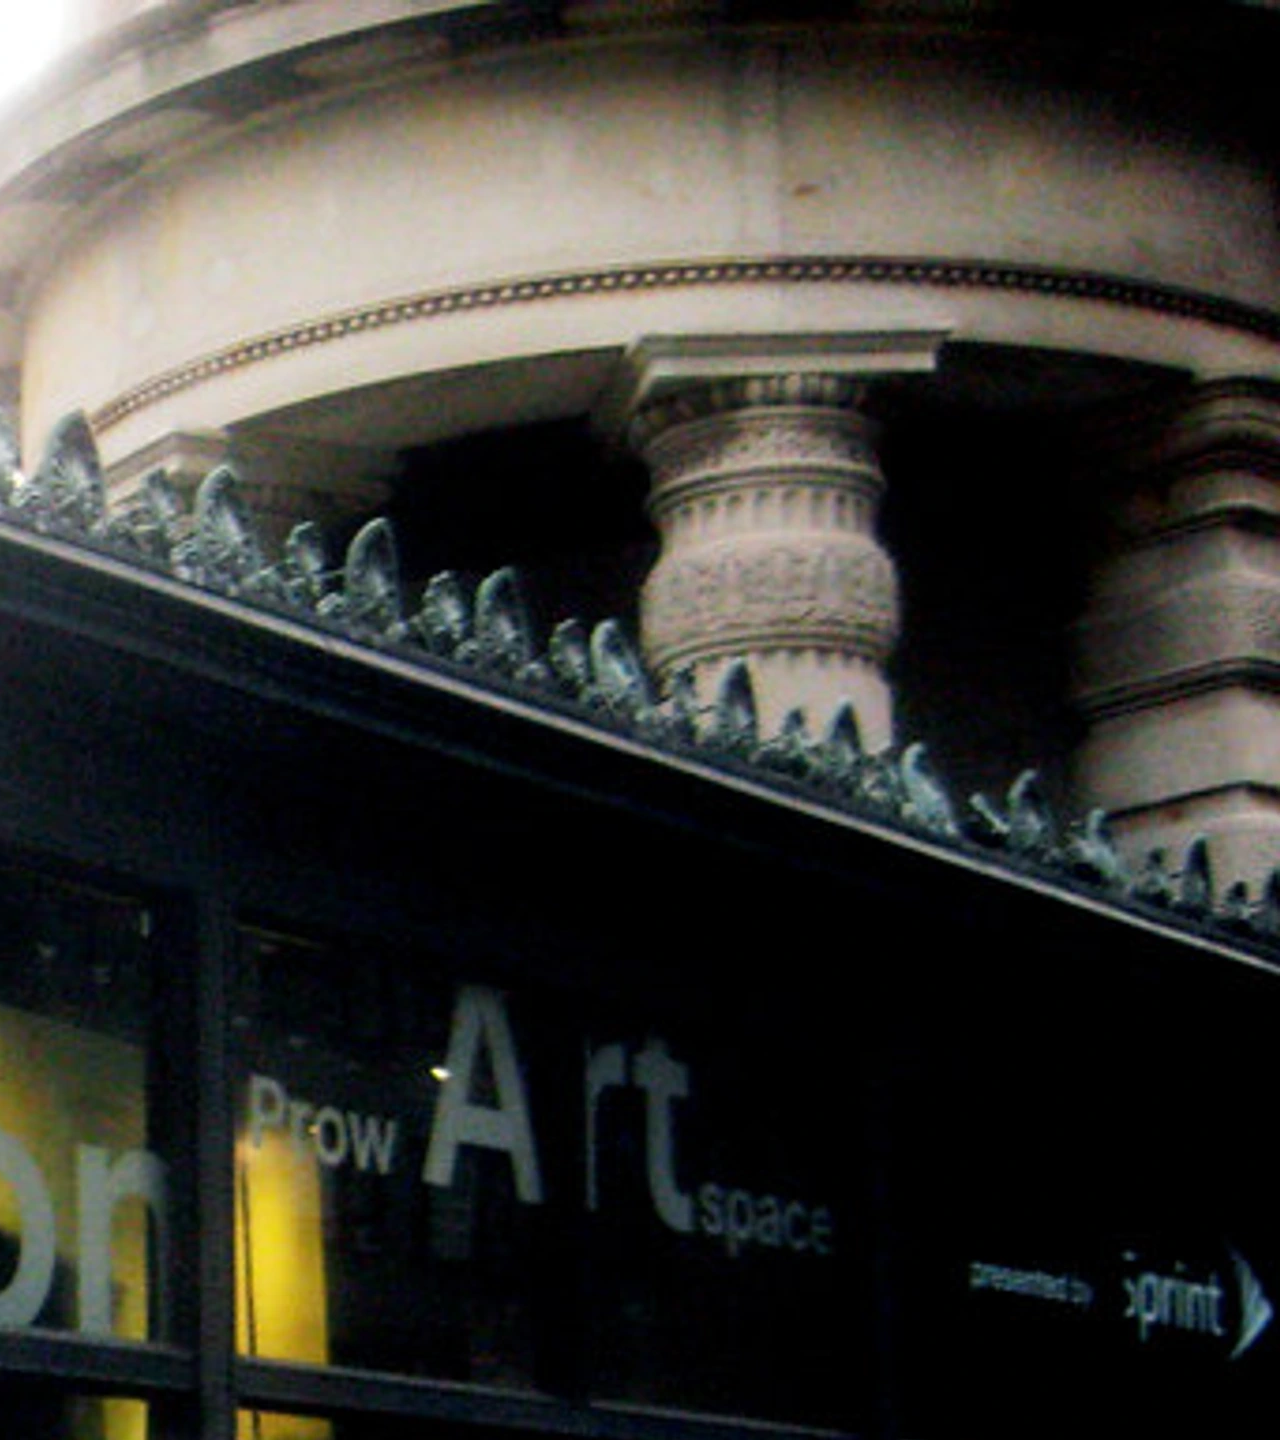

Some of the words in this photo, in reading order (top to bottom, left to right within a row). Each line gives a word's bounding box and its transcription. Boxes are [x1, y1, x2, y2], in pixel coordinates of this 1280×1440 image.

[250, 1073, 401, 1177] Prow
[419, 980, 698, 1237] Art
[697, 1180, 836, 1261] space
